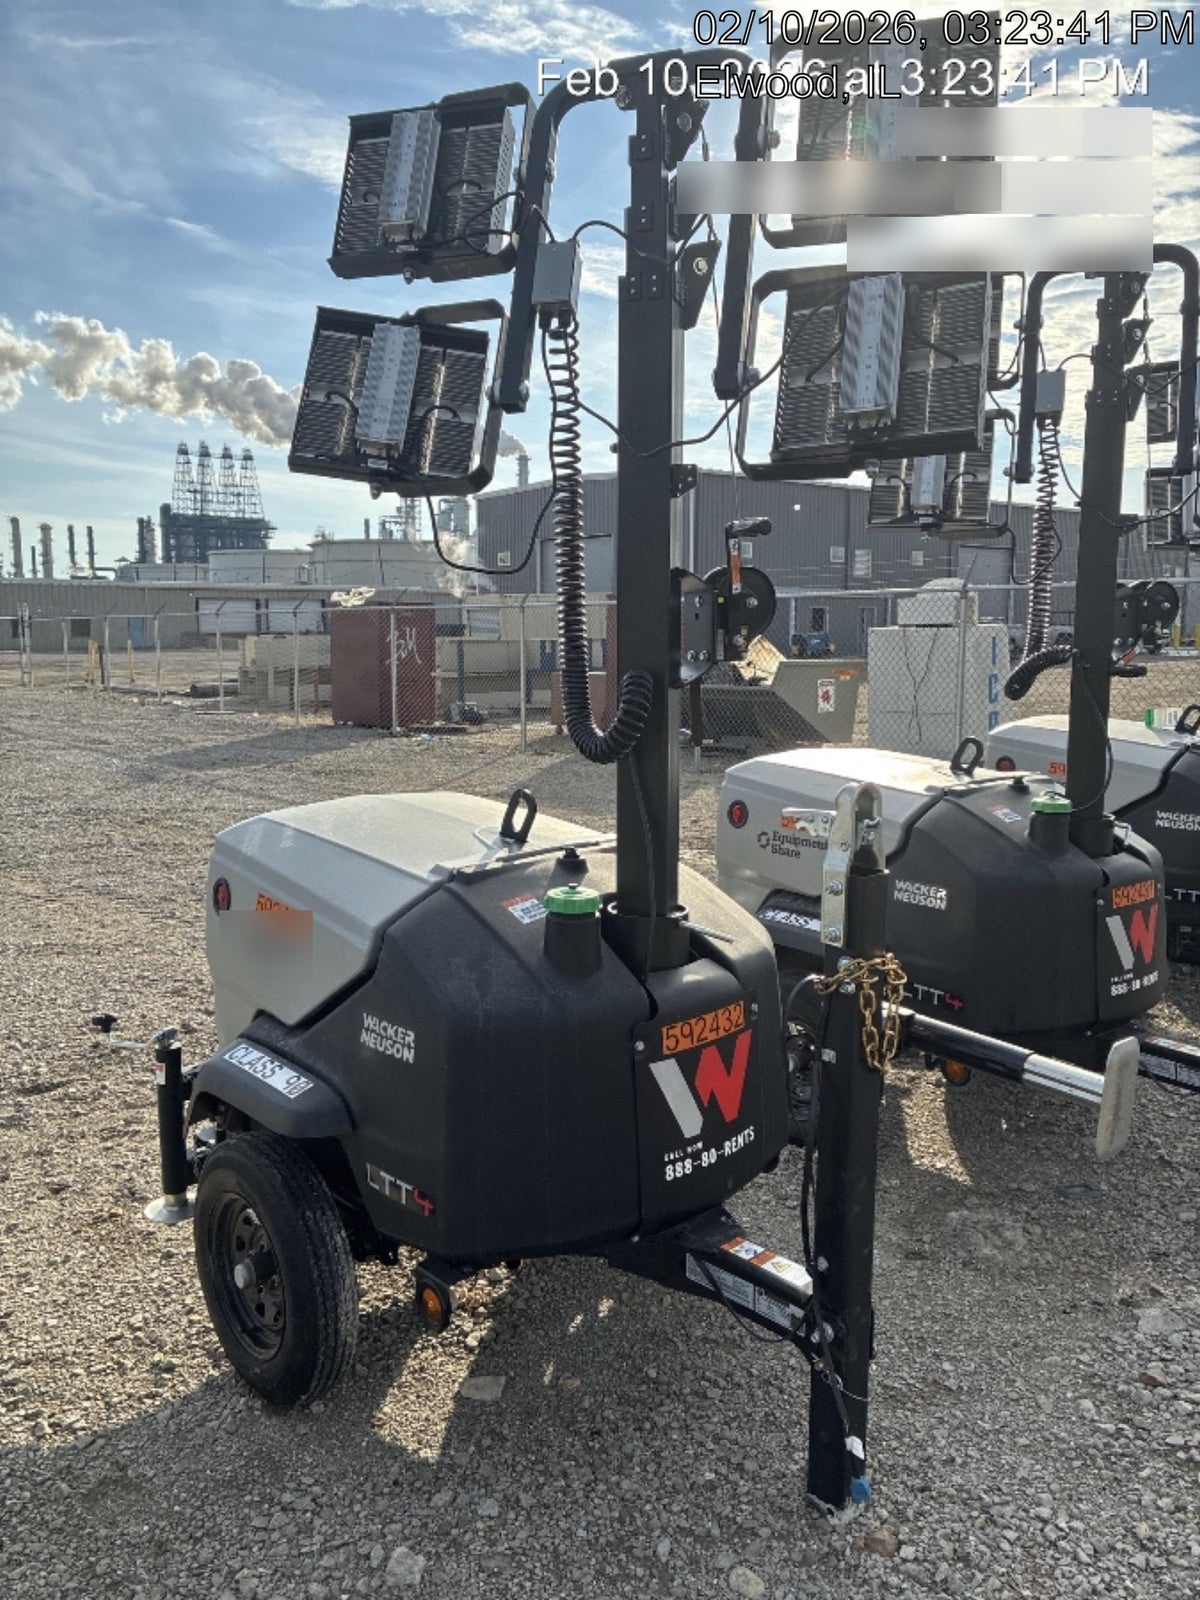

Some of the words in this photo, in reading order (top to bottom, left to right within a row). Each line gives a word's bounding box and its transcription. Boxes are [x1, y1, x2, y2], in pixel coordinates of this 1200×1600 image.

[771, 844, 801, 859] Share
[893, 890, 947, 911] NEUSON
[895, 879, 946, 899] WACKER
[362, 1012, 415, 1048] WACKER
[665, 1003, 744, 1052] 592432
[229, 1046, 284, 1080] CLASS
[360, 1028, 415, 1064] NEUSON
[665, 1125, 755, 1181] 888-80-RENTS
[366, 1163, 436, 1217] LTT4
